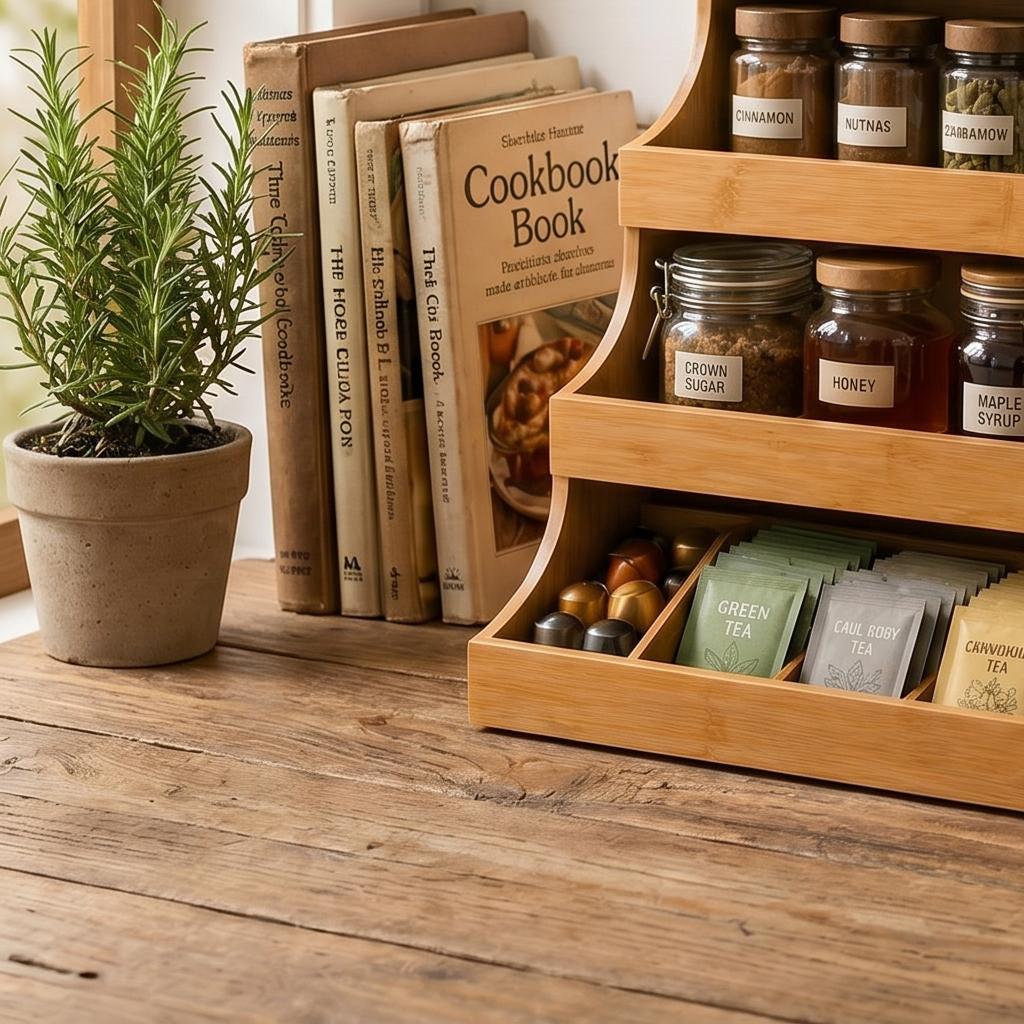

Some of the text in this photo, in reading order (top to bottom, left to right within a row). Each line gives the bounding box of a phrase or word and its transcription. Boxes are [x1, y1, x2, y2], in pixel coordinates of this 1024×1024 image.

[735, 108, 795, 125] CINNAMON
[845, 116, 892, 134] NUTNAS
[464, 140, 620, 209] Cookbook
[511, 197, 586, 248] Book
[684, 360, 728, 378] CROWN
[684, 377, 726, 394] SUGAR
[832, 375, 876, 393] HONEY
[977, 393, 1022, 411] MAPLE
[977, 410, 1022, 429] SYRUP
[717, 599, 770, 621] GREEN
[725, 620, 752, 639] TEA
[851, 639, 873, 656] TEA
[987, 658, 1008, 674] TEA
